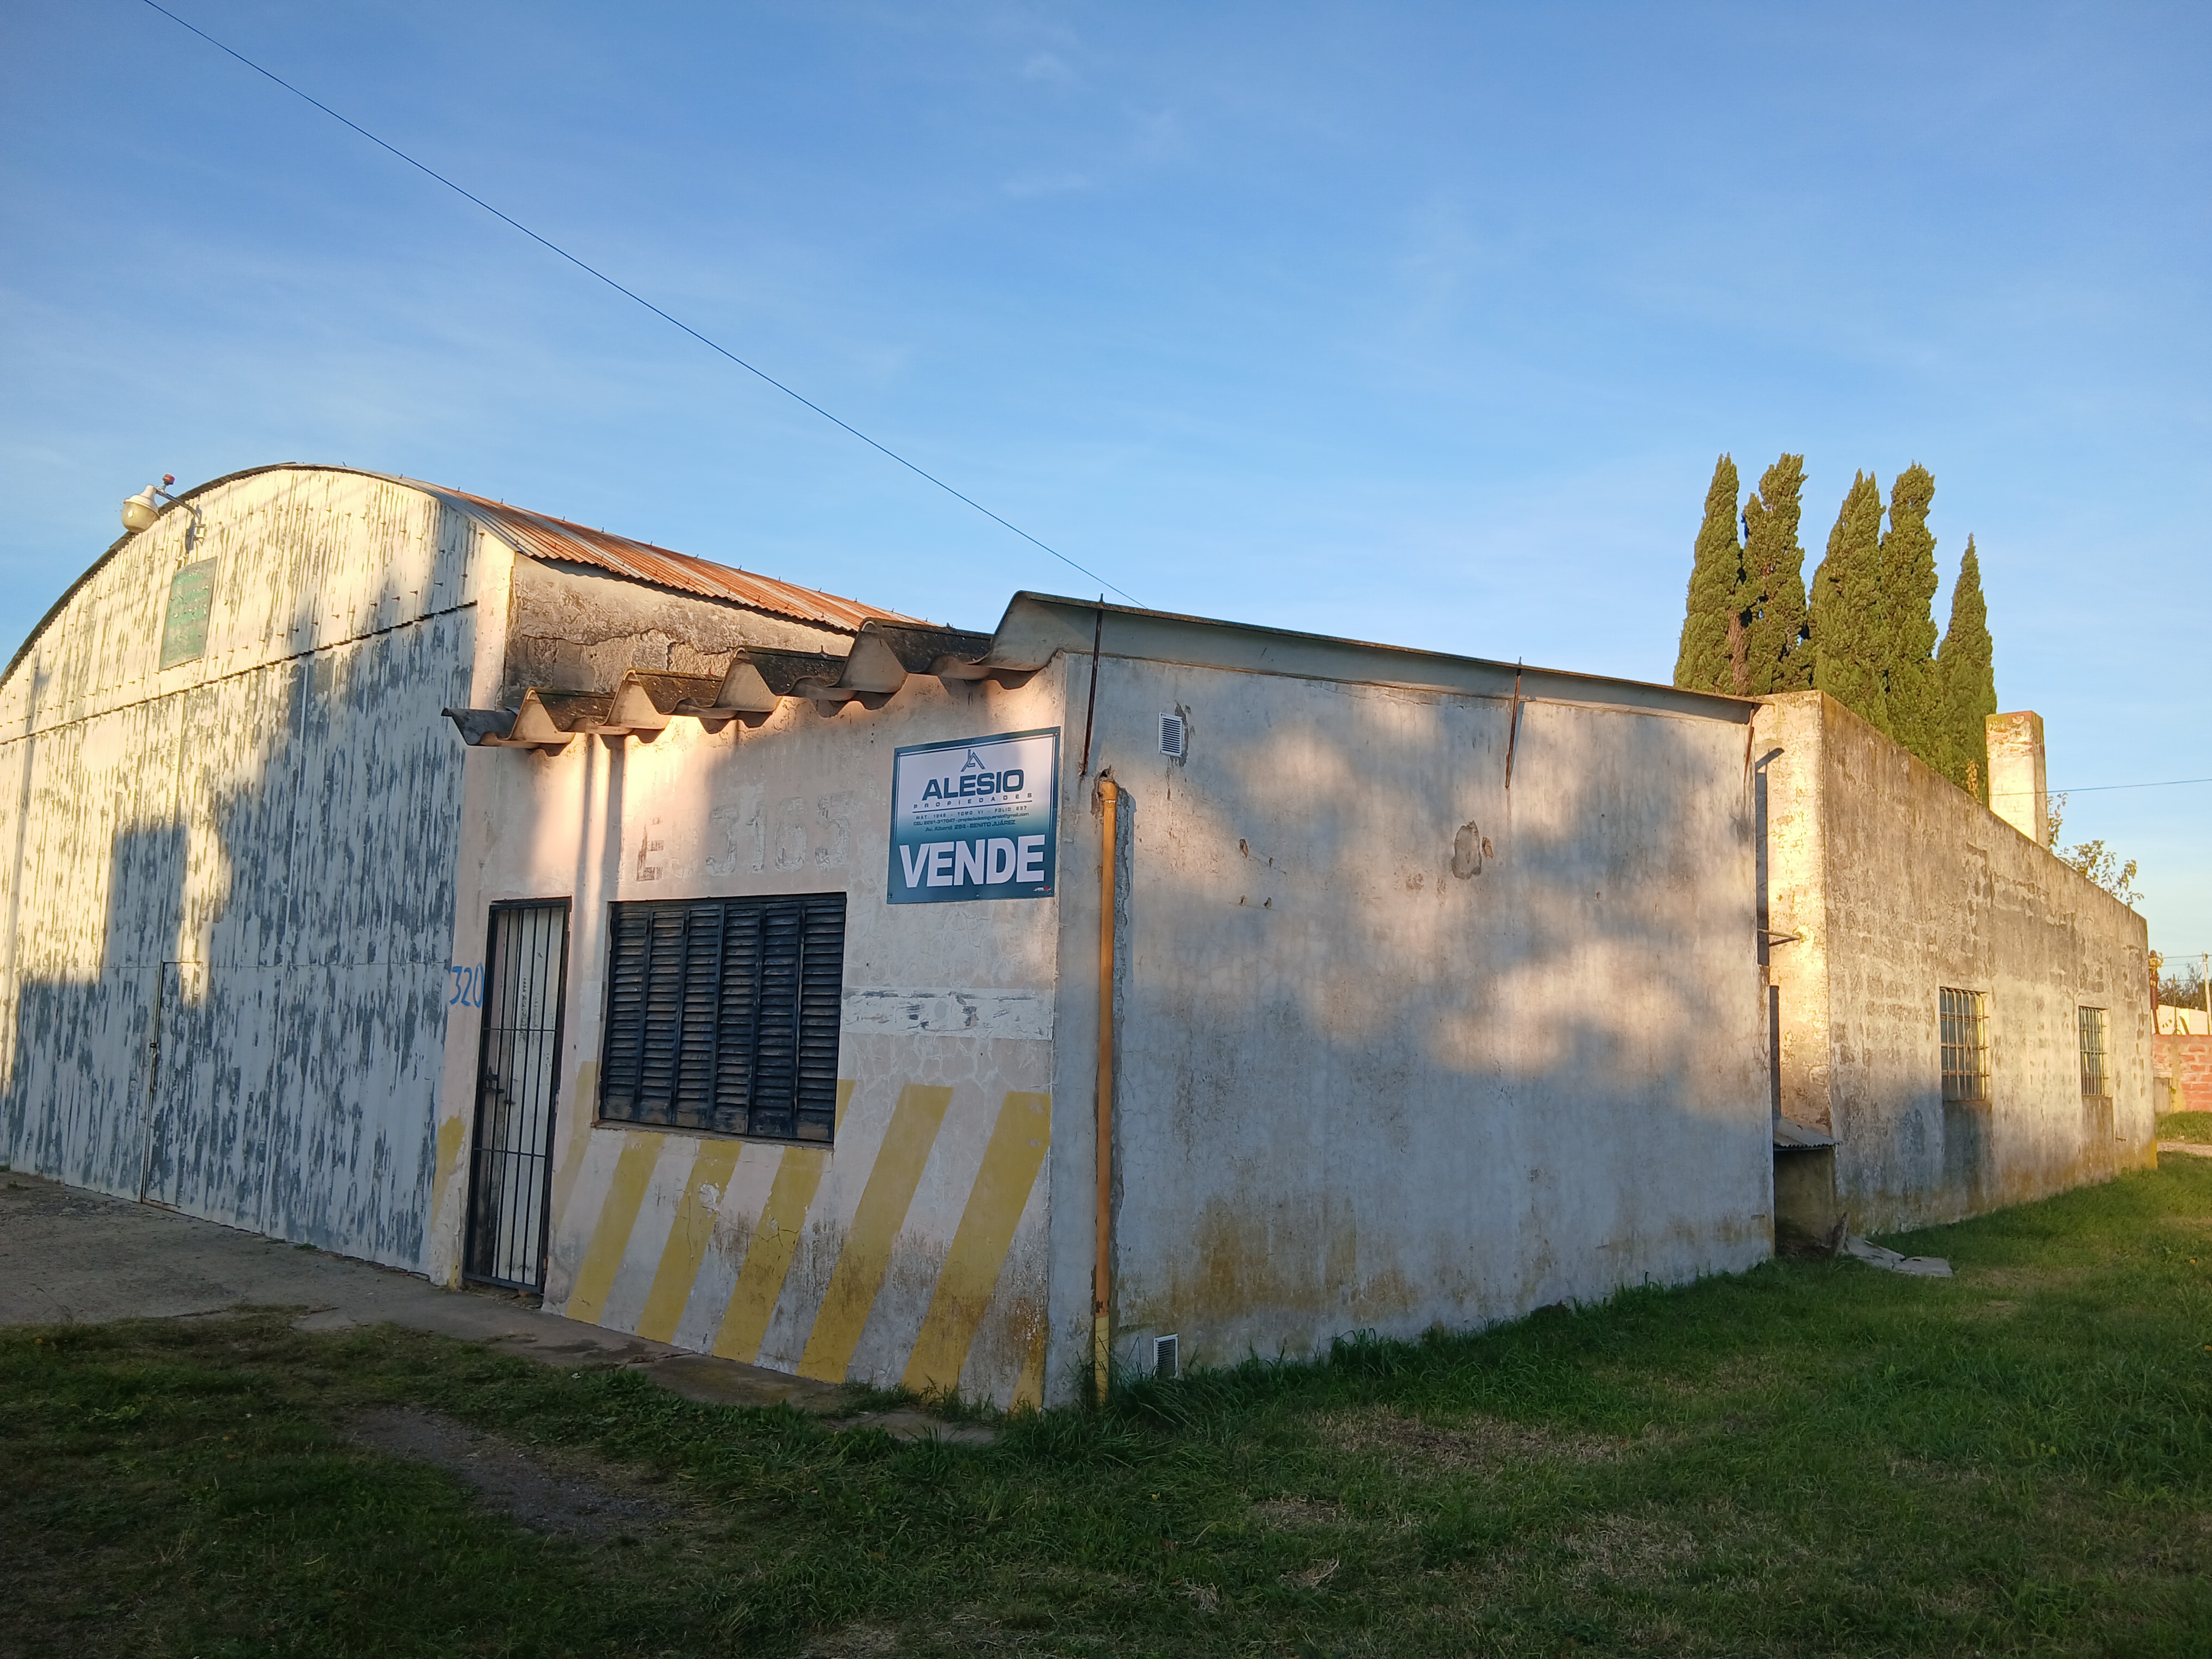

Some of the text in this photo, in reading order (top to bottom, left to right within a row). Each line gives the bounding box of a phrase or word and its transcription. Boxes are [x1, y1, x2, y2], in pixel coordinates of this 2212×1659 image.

[914, 793, 1032, 808] PROPIEDADES
[922, 769, 1024, 801] ALESIO
[899, 834, 1045, 888] VENDE
[449, 962, 485, 1008] 320
